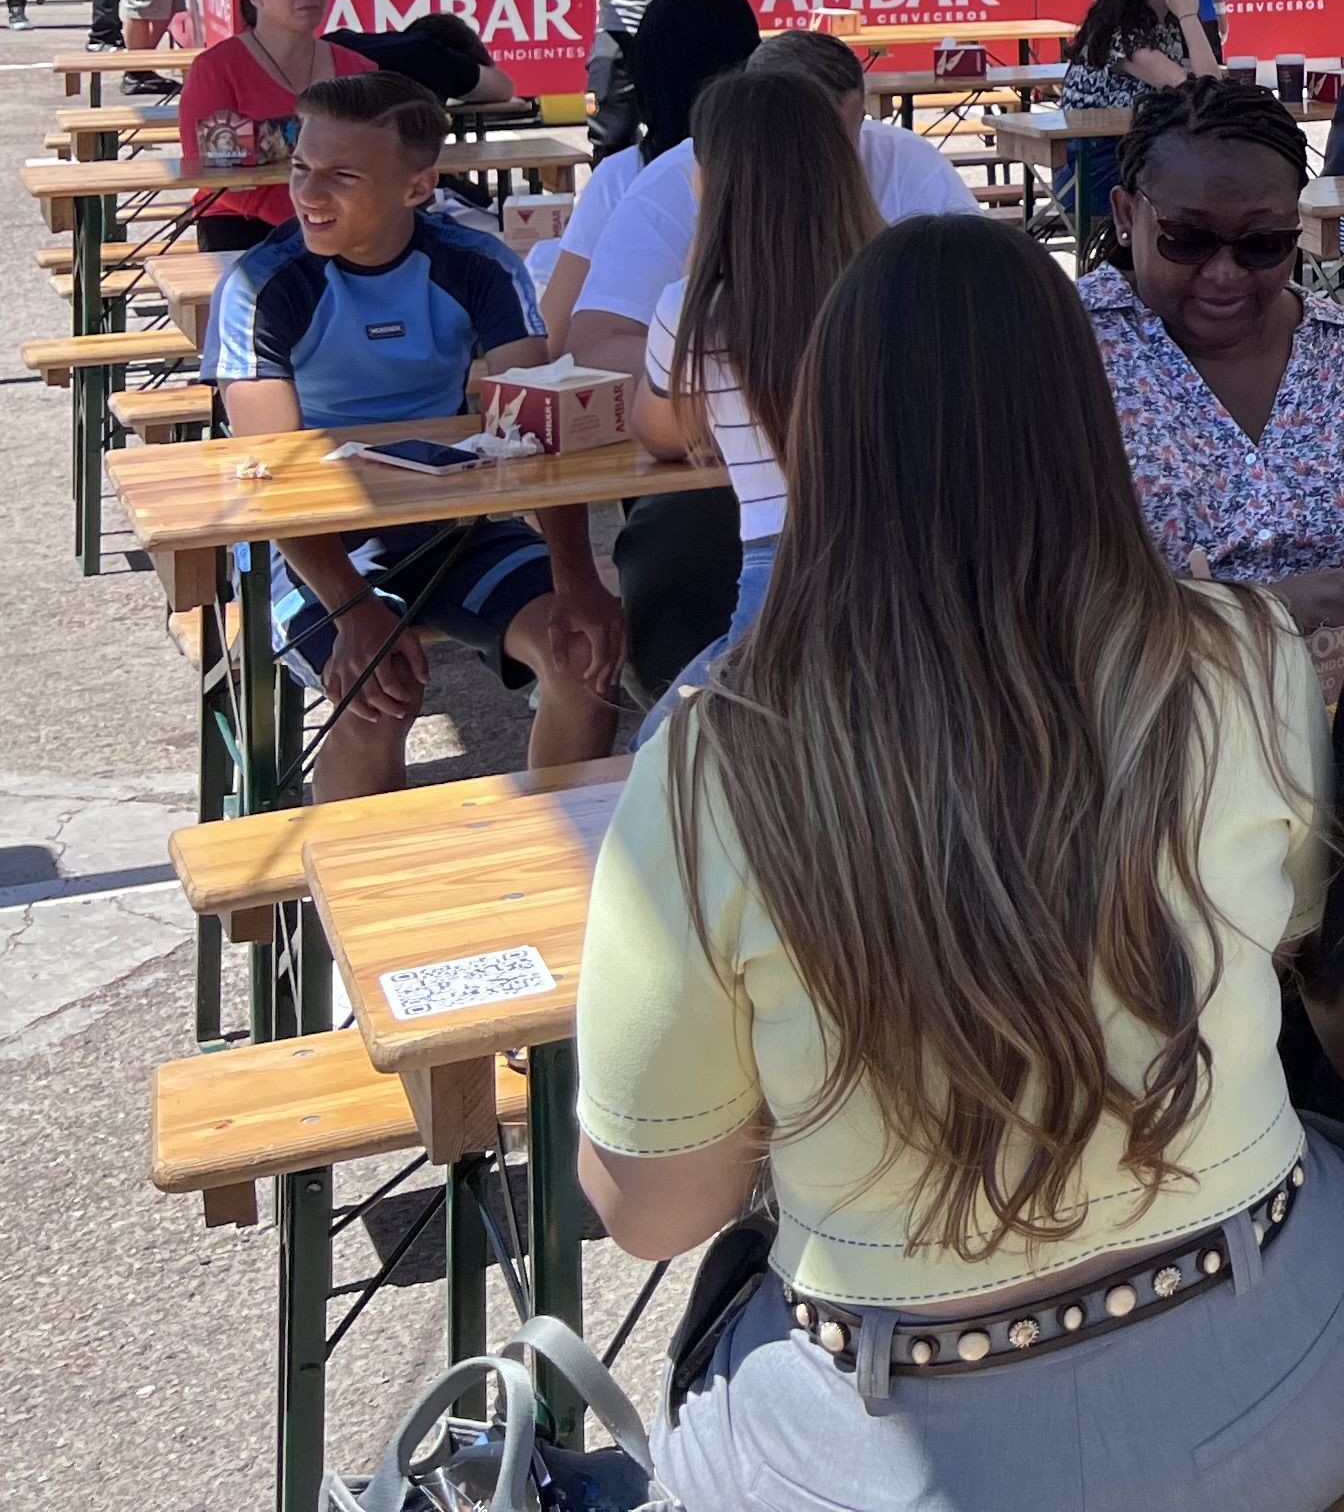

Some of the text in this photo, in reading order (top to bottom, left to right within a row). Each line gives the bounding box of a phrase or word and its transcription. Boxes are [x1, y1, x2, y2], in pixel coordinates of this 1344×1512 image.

[1225, 0, 1325, 14] CERVECEROS
[877, 10, 988, 25] CERVECEROS
[614, 383, 626, 433] AMBAR
